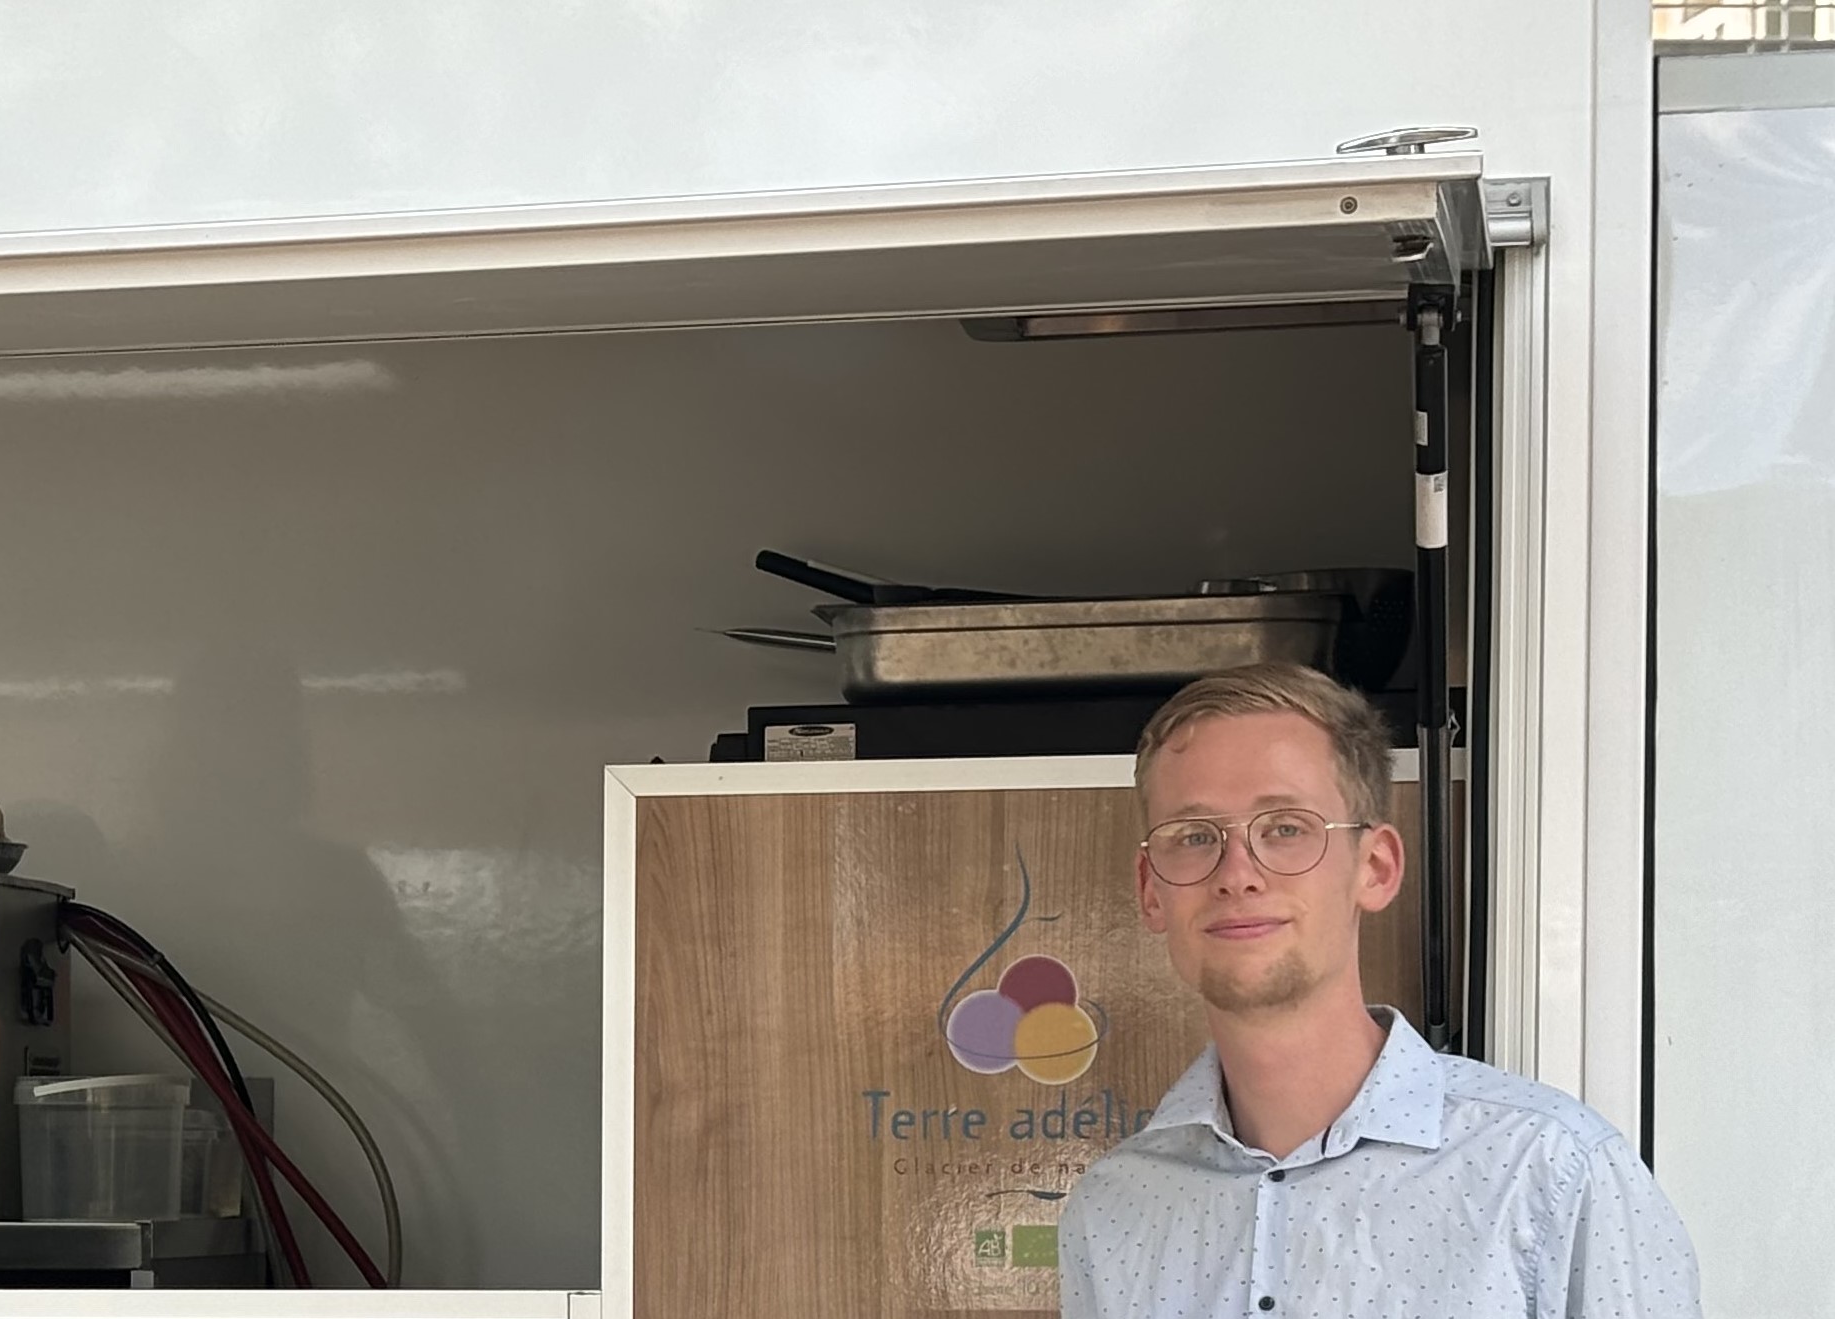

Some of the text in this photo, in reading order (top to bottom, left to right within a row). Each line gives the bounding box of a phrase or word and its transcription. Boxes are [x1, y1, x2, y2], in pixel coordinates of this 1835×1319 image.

[862, 1088, 1155, 1141] Terre adélic
[893, 1156, 994, 1176] Glacier
[1010, 1156, 1042, 1175] de
[977, 1238, 1002, 1257] AB
